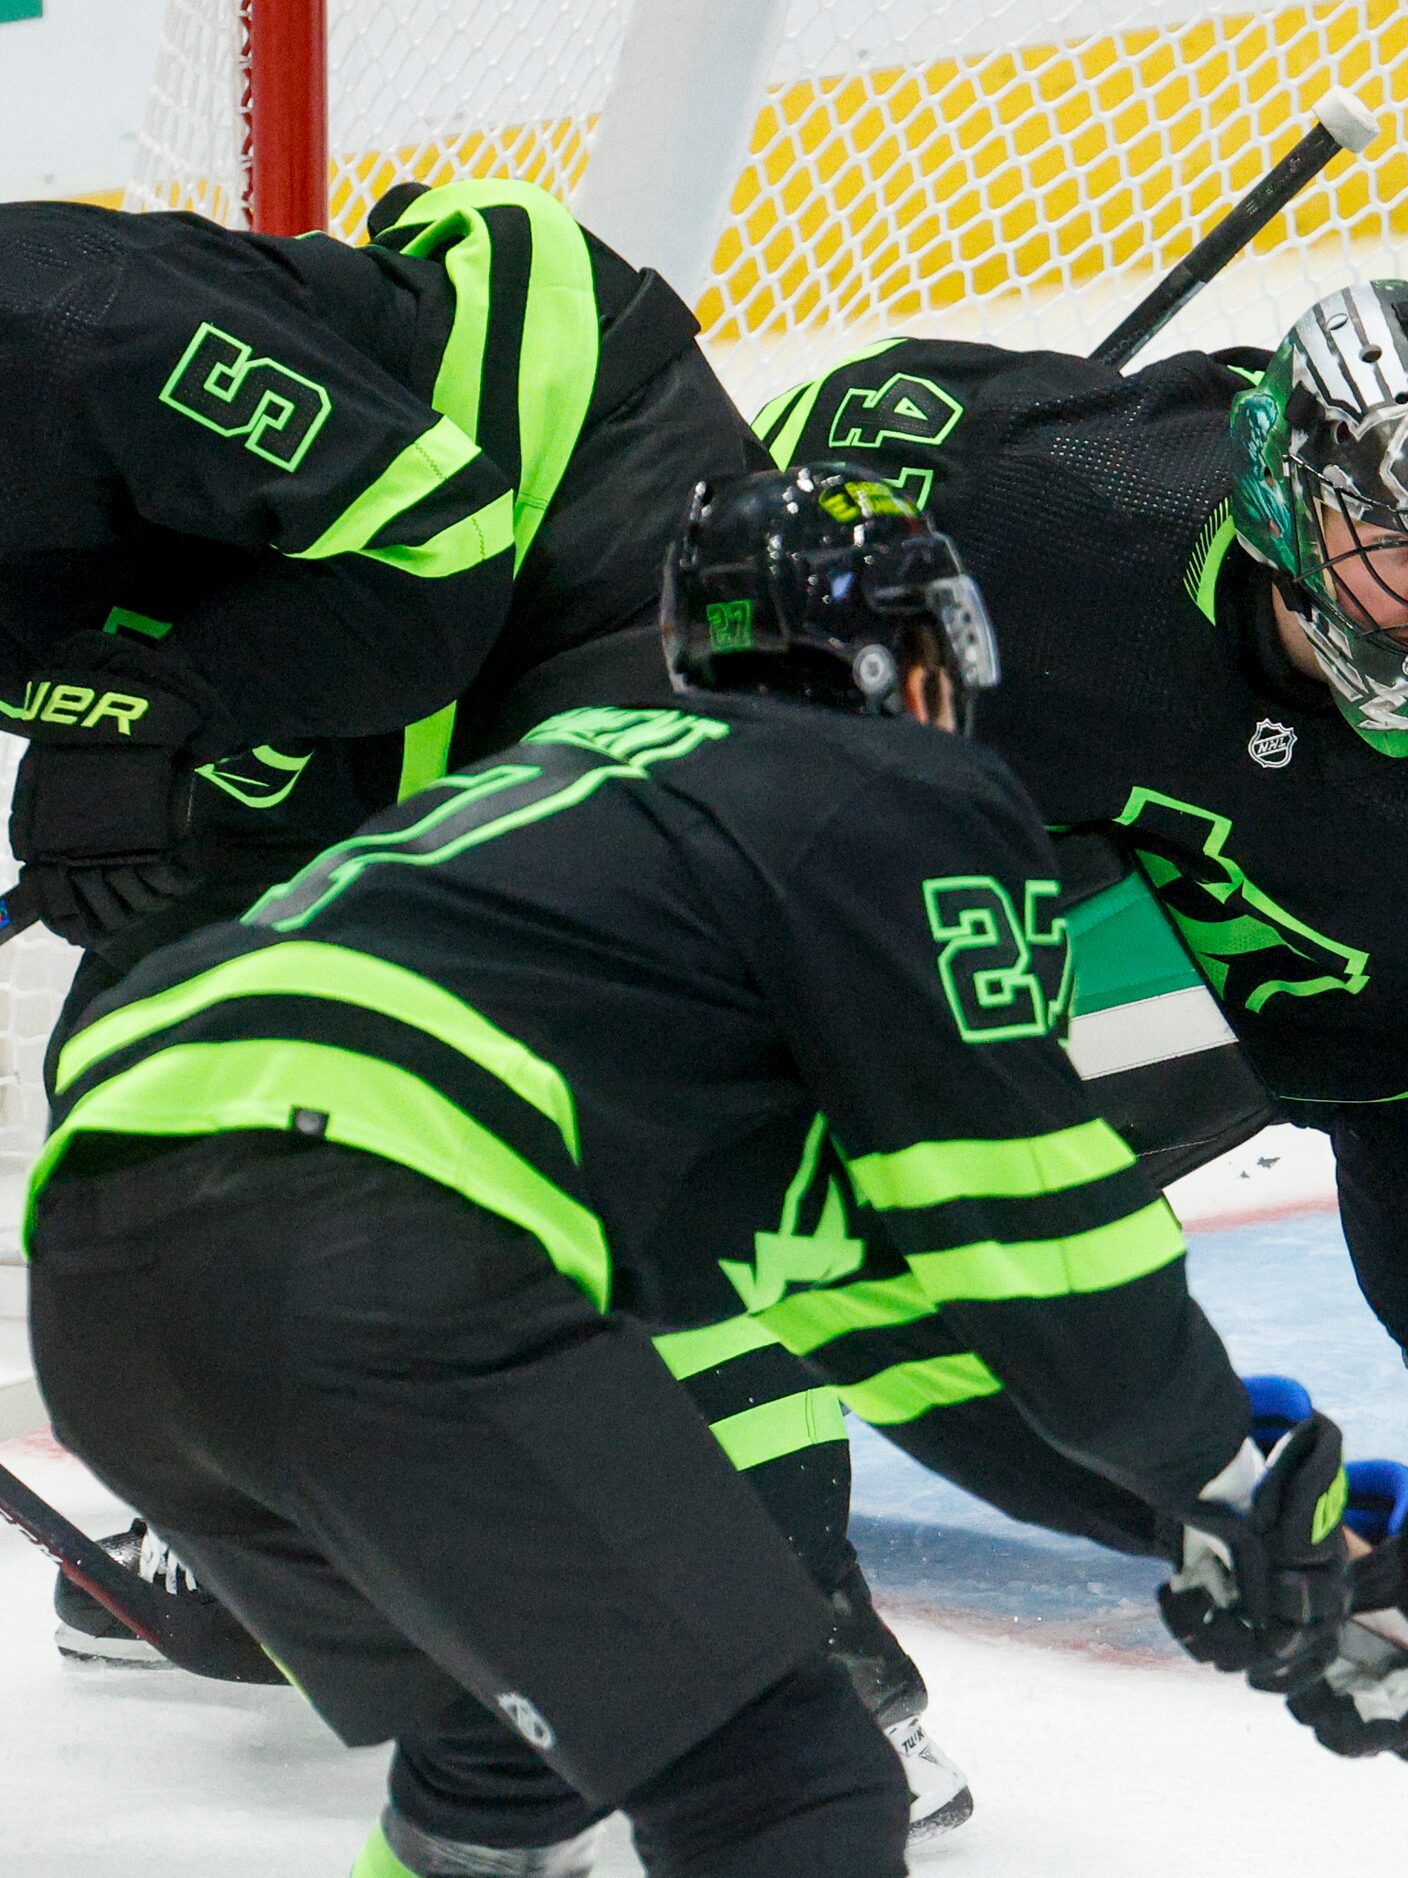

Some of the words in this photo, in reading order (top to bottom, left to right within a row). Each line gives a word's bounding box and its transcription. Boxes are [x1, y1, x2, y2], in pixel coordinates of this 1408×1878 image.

[158, 321, 332, 473] 5
[706, 599, 752, 653] 27
[22, 680, 149, 736] UER
[1257, 736, 1287, 754] NHL
